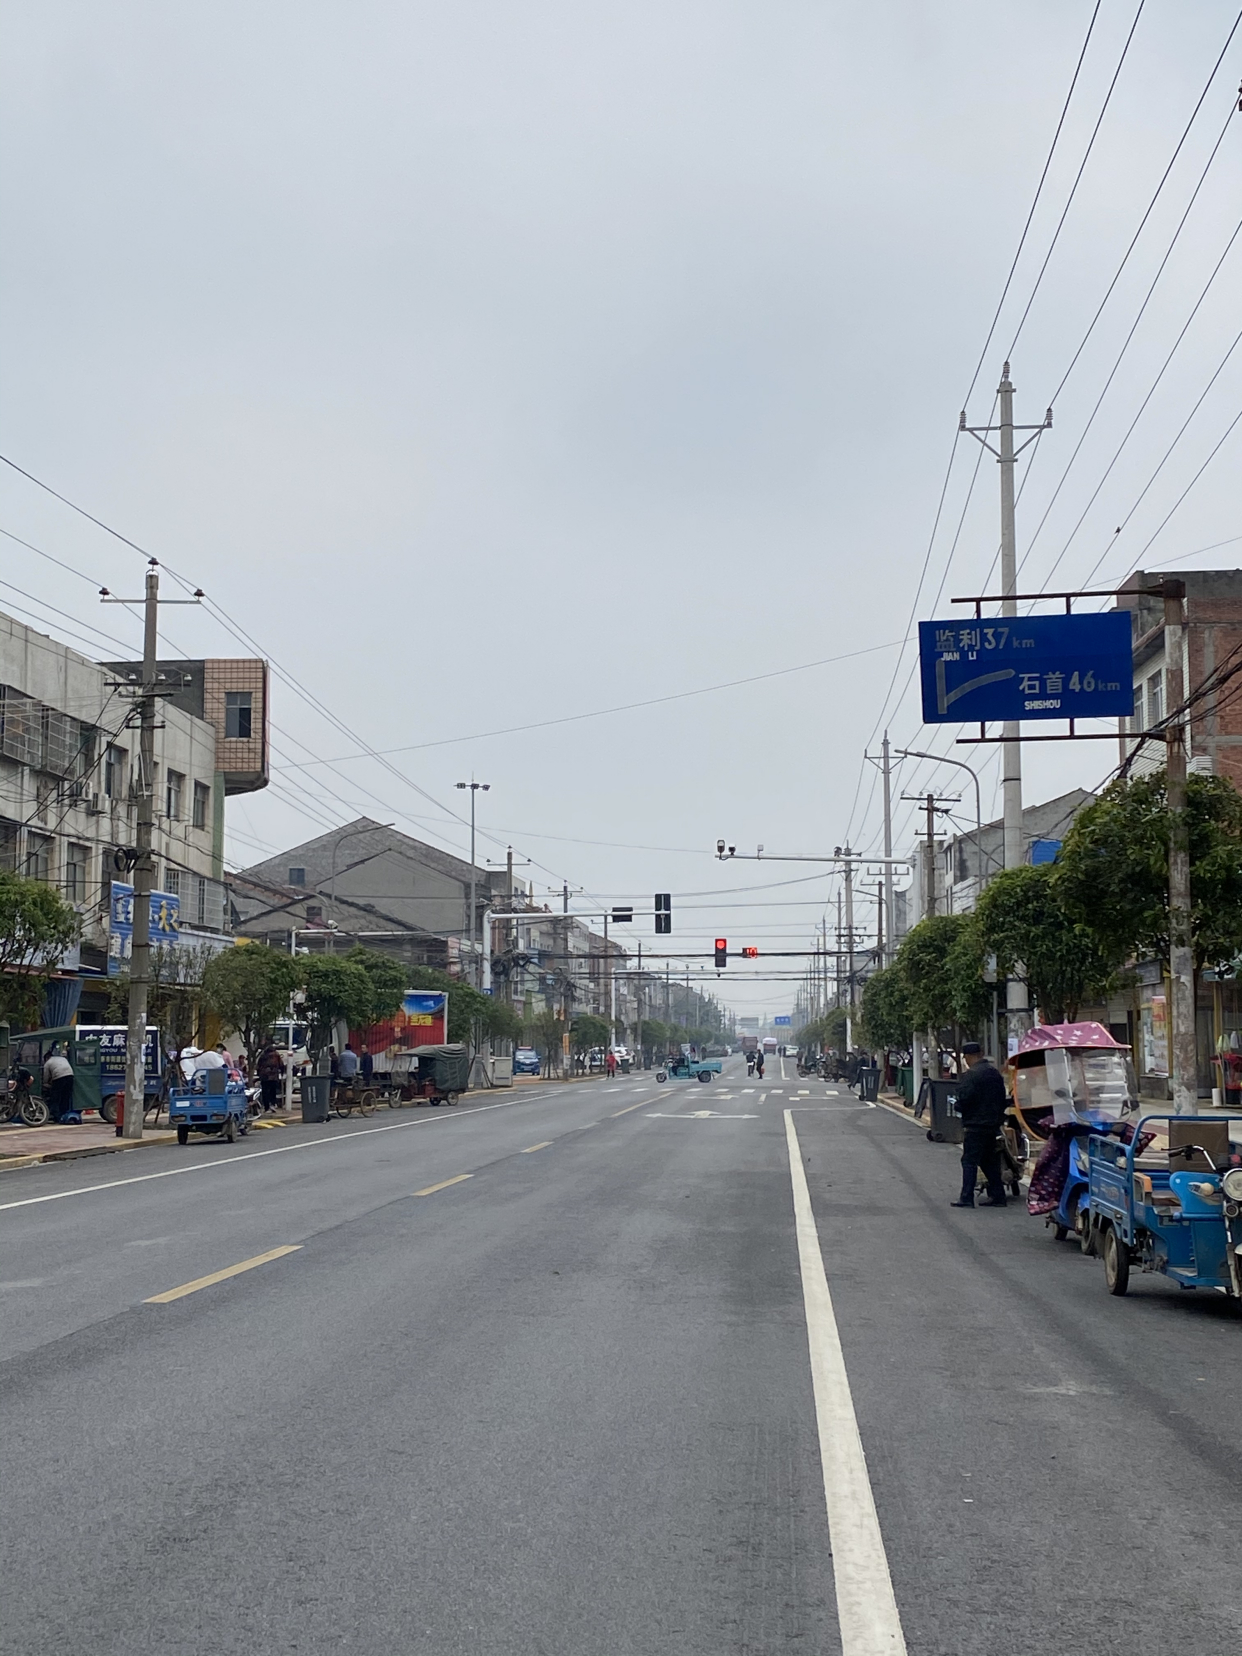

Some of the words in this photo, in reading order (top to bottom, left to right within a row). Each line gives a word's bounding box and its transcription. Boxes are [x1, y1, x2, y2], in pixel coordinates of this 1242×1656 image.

[941, 652, 960, 661] JIAN
[968, 651, 977, 660] LI
[1024, 699, 1061, 710] SHISHOU
